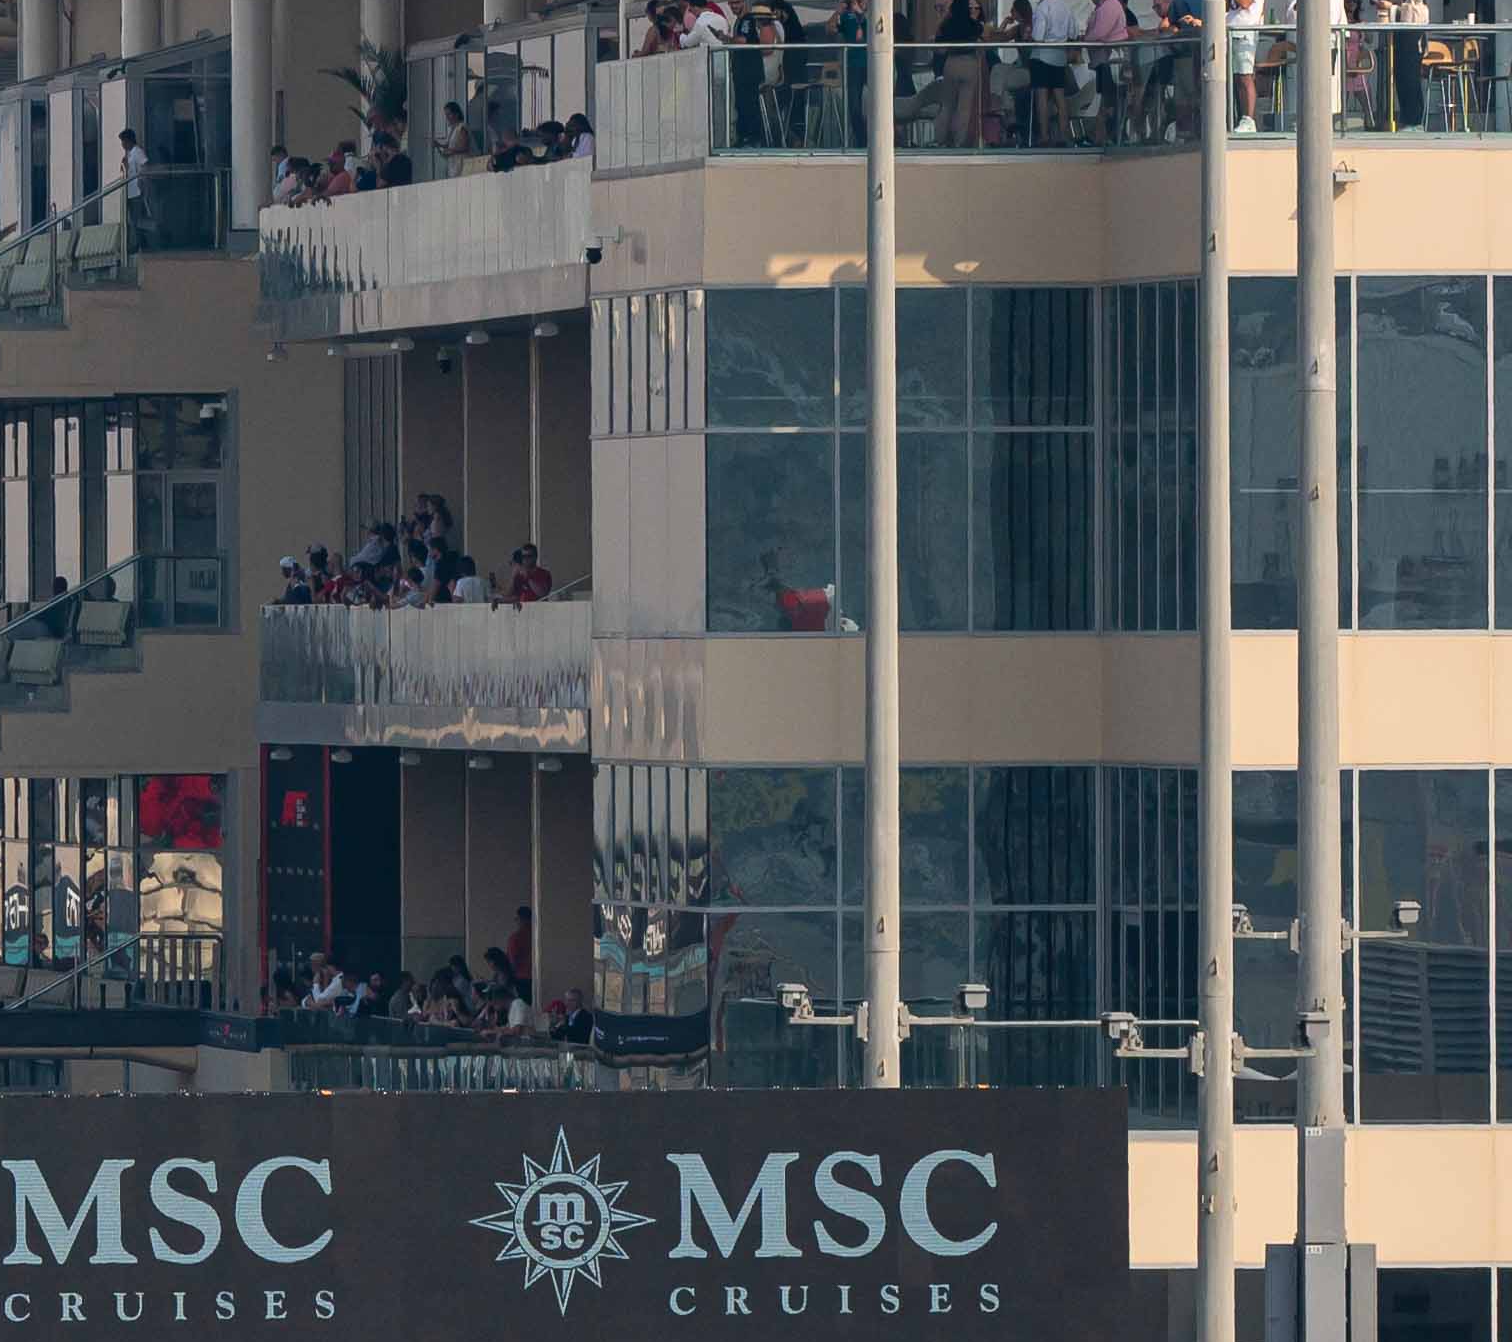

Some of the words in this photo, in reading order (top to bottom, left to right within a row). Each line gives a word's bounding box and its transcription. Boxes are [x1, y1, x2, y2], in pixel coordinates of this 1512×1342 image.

[1, 1156, 335, 1266] MSC
[666, 1149, 999, 1260] MSC
[3, 1290, 337, 1323] CRUISES
[668, 1284, 1002, 1316] CRUISES
